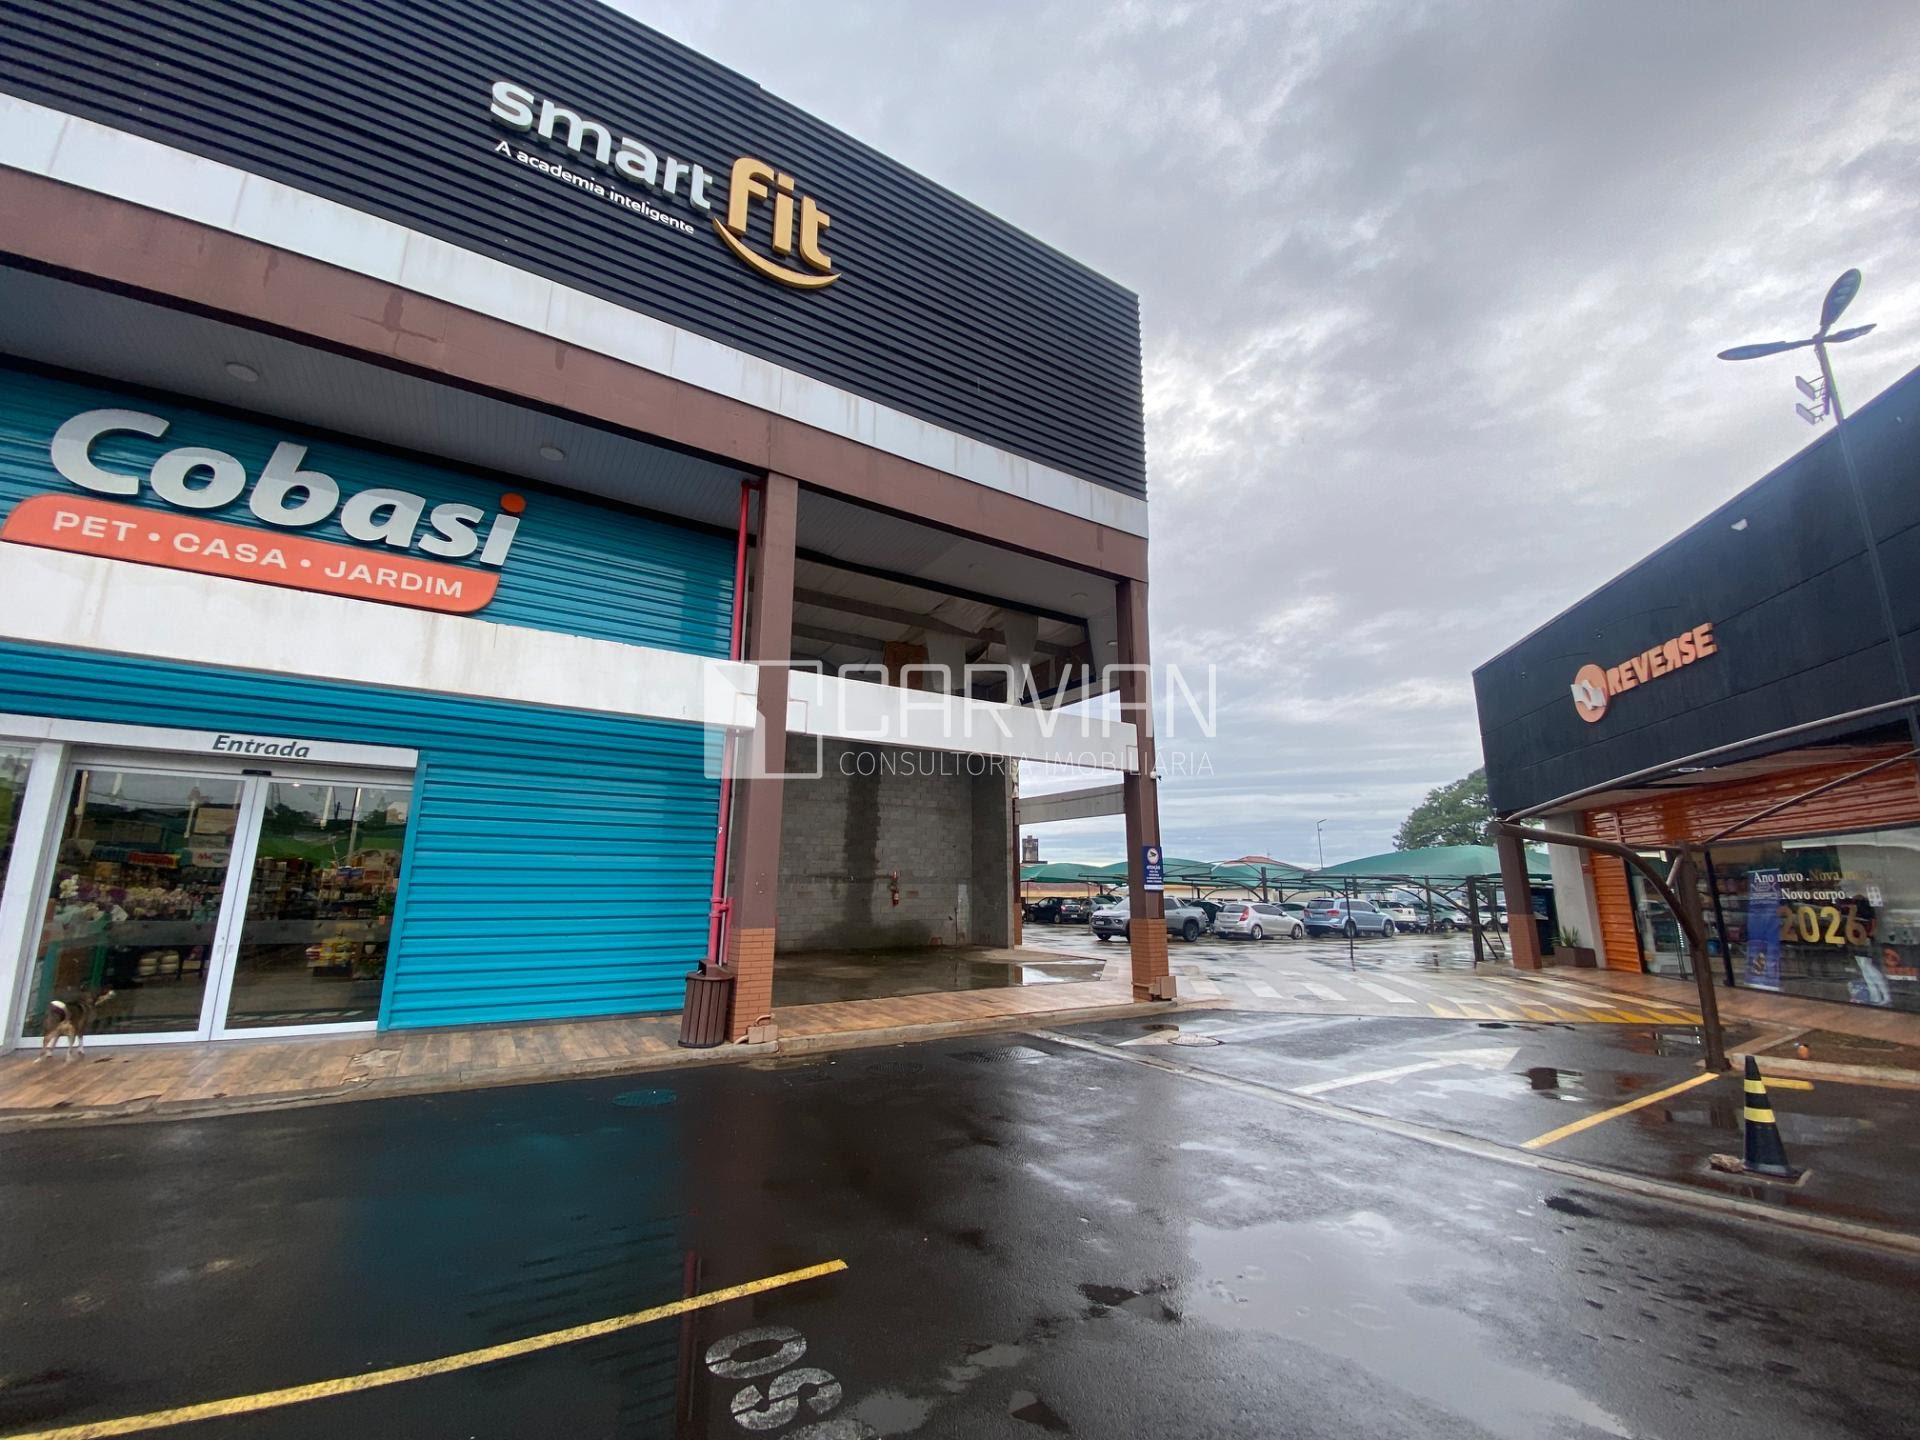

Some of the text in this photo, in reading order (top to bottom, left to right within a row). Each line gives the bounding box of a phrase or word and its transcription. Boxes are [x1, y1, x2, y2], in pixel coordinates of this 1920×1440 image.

[490, 81, 832, 272] smart fit
[495, 140, 695, 234] A academia inteligente
[50, 408, 527, 566] Cobasi
[52, 510, 463, 598] PET CASA JARDIM
[1605, 622, 1718, 697] REVERSE
[212, 734, 311, 758] Entrada
[1753, 872, 1775, 883] Ano
[1781, 888, 1811, 900] Novo
[1777, 905, 1868, 946] 2026
